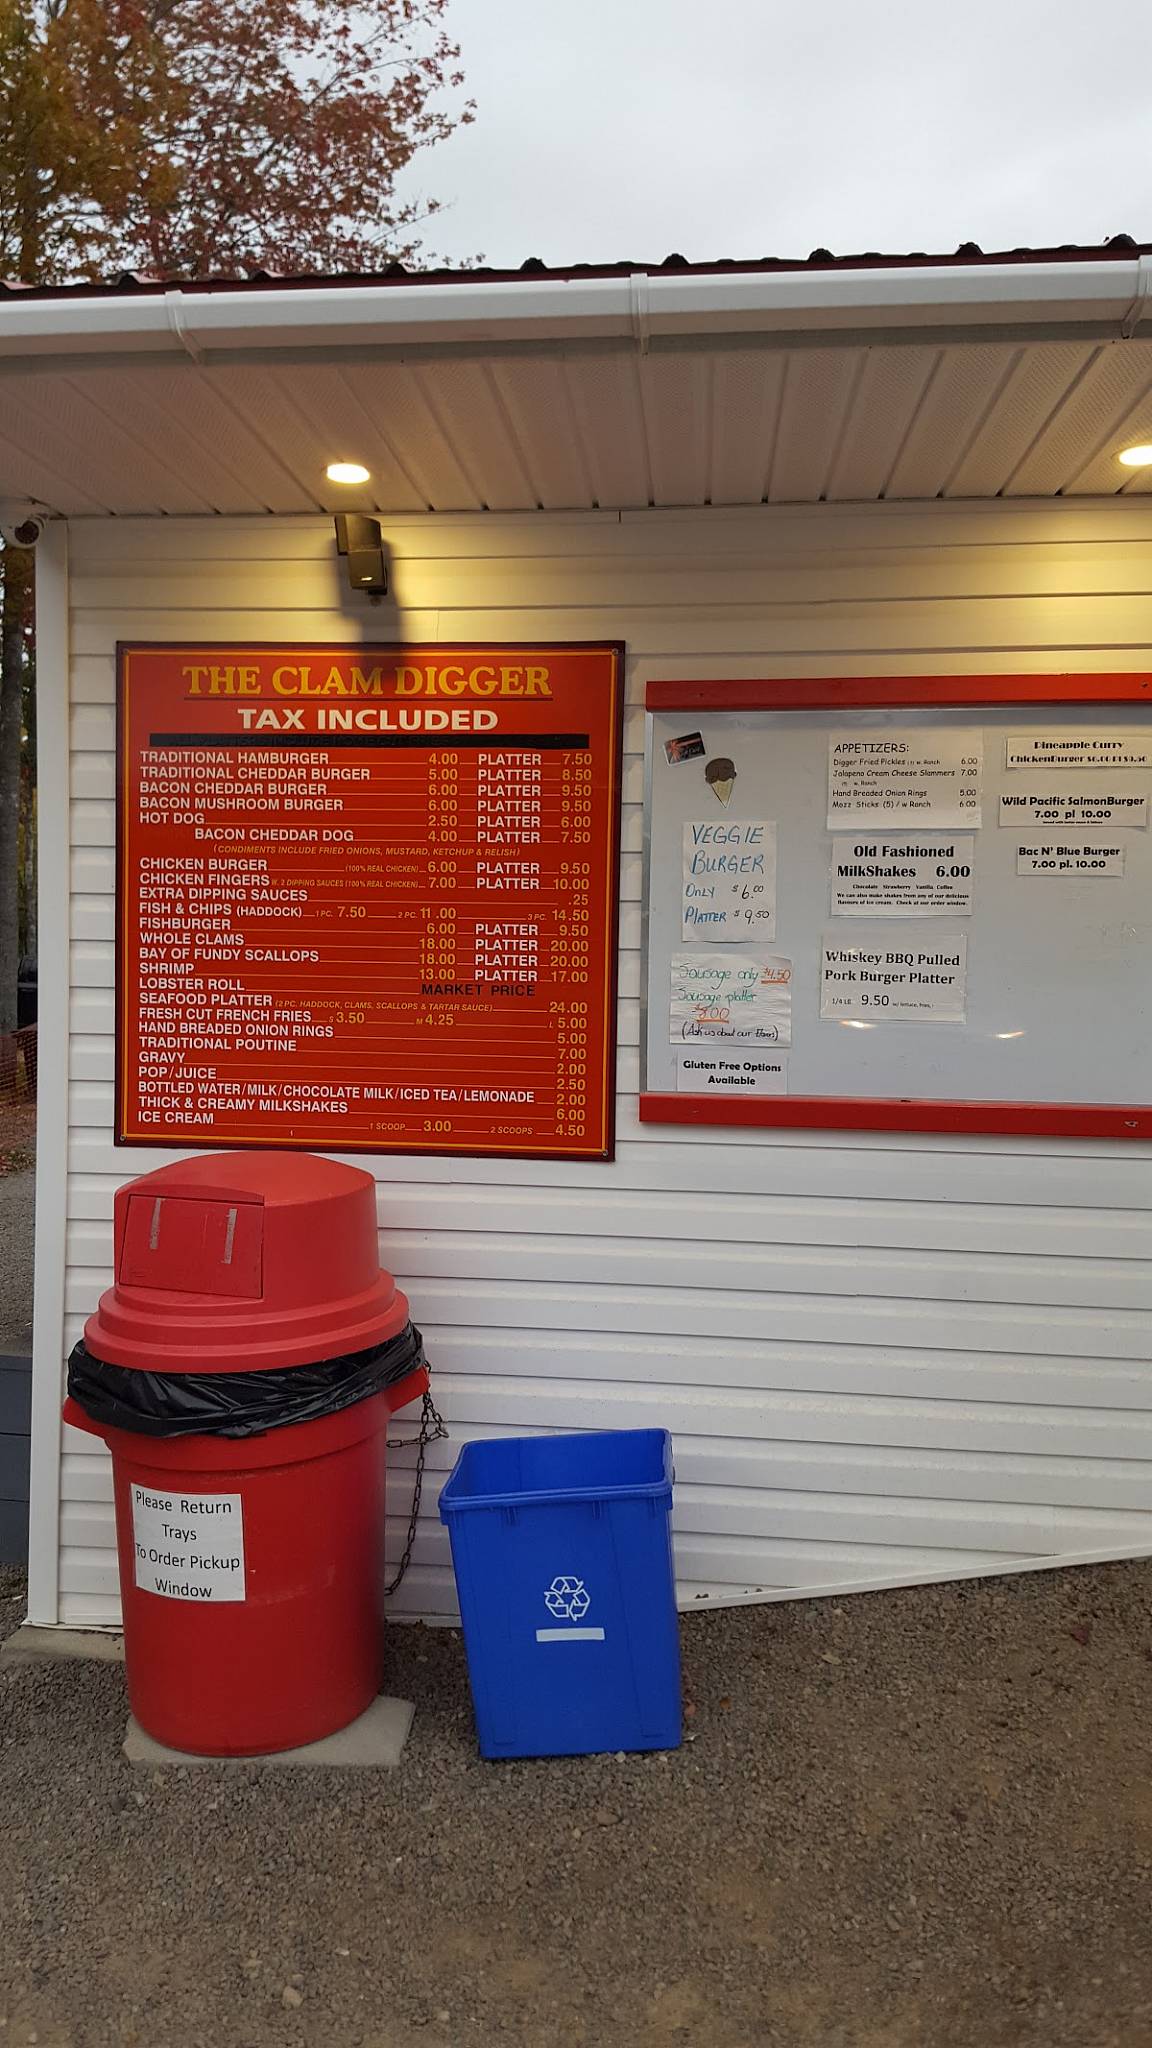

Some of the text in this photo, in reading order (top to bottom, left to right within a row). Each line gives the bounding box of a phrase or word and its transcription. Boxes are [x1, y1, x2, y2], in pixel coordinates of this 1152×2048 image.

[182, 666, 552, 696] THE CLAM DIGGER
[238, 709, 499, 731] TAX INCLUDED
[834, 743, 909, 754] APPETIZERS:
[141, 751, 458, 765] TRADITIONAL HAMBURGER 4.00
[834, 759, 857, 768] Digger
[141, 767, 458, 781] TRADITIONAL CHEDDAR BURGER 5.00
[833, 770, 865, 778] Jalapeno
[140, 782, 458, 796] BACON CHEDDAR BURGER 6.00
[908, 790, 928, 798] Rings
[140, 797, 458, 811] BACON MUSHROOM BURGER 6.00
[1002, 797, 1145, 807] Wild Pacific SalmonBurger
[140, 812, 458, 827] HOT DOG 2.50
[1065, 810, 1075, 819] pl
[195, 828, 458, 842] BACON CHEDDAR DOG 4.00
[692, 825, 764, 845] VEGGIE
[214, 844, 276, 854] (CONDIMENTS
[278, 846, 317, 854] INCLUDE
[346, 847, 382, 856] ONIONS,
[386, 848, 431, 856] MUSTARD,
[433, 848, 474, 856] KETCHUP
[485, 848, 520, 857] RELISH)
[854, 846, 955, 858] Old Fashioned
[1019, 847, 1039, 856] Bac
[1057, 847, 1081, 855] Blue
[1083, 847, 1120, 856] Burger
[140, 858, 457, 873] CHICKEN BURGER 6.00
[838, 866, 971, 878] MilkShakes 6.00
[1032, 861, 1056, 869] 7.00
[1076, 861, 1106, 869] 10.00
[140, 873, 457, 889] CHICKEN FINGERS 7.00
[140, 888, 308, 901] EXTRA DIPPING SAUCES
[140, 903, 302, 918] FISH & CHIPS (HADDOCK)
[140, 918, 456, 934] FISHBURGER 6.00
[140, 933, 456, 950] WHOLE CLAMS 18.00
[140, 948, 456, 965] BAY OF FUNDY SCALLOPS 18.00
[825, 951, 960, 967] Whiskey BBQ Pulled
[140, 963, 456, 980] SHRIMP 13.00
[679, 963, 732, 990] Sausage
[738, 967, 760, 988] only
[825, 970, 955, 985] Pork Burger Platter
[140, 978, 536, 997] LOBSTER ROLL MARKET PRICE
[139, 993, 207, 1005] SEAFOOD
[675, 987, 757, 1008] Sausage platter
[861, 995, 890, 1006] 9.50
[139, 1008, 311, 1022] FRESH CUT FRENCH FRIES
[139, 1022, 334, 1037] HAND BREADED ONION RINGS
[139, 1037, 297, 1051] TRADITIONAL POUTINE
[139, 1052, 185, 1064] GRAVY
[139, 1066, 217, 1080] POP/JUICE
[683, 1060, 781, 1074] Gluten Free Options
[708, 1075, 756, 1085] Available
[139, 1082, 535, 1103] BOTTLED WATER/MILK/CHOCOLATE MILK/ICED TEA/LEMONADE
[139, 1096, 348, 1113] THICK & CREAMY MILKSHAKES
[138, 1111, 214, 1124] ICE CREAM
[136, 1491, 232, 1514] Please Return
[162, 1524, 197, 1542] Trays
[136, 1543, 240, 1571] To Order Pickup
[155, 1578, 212, 1598] Window
